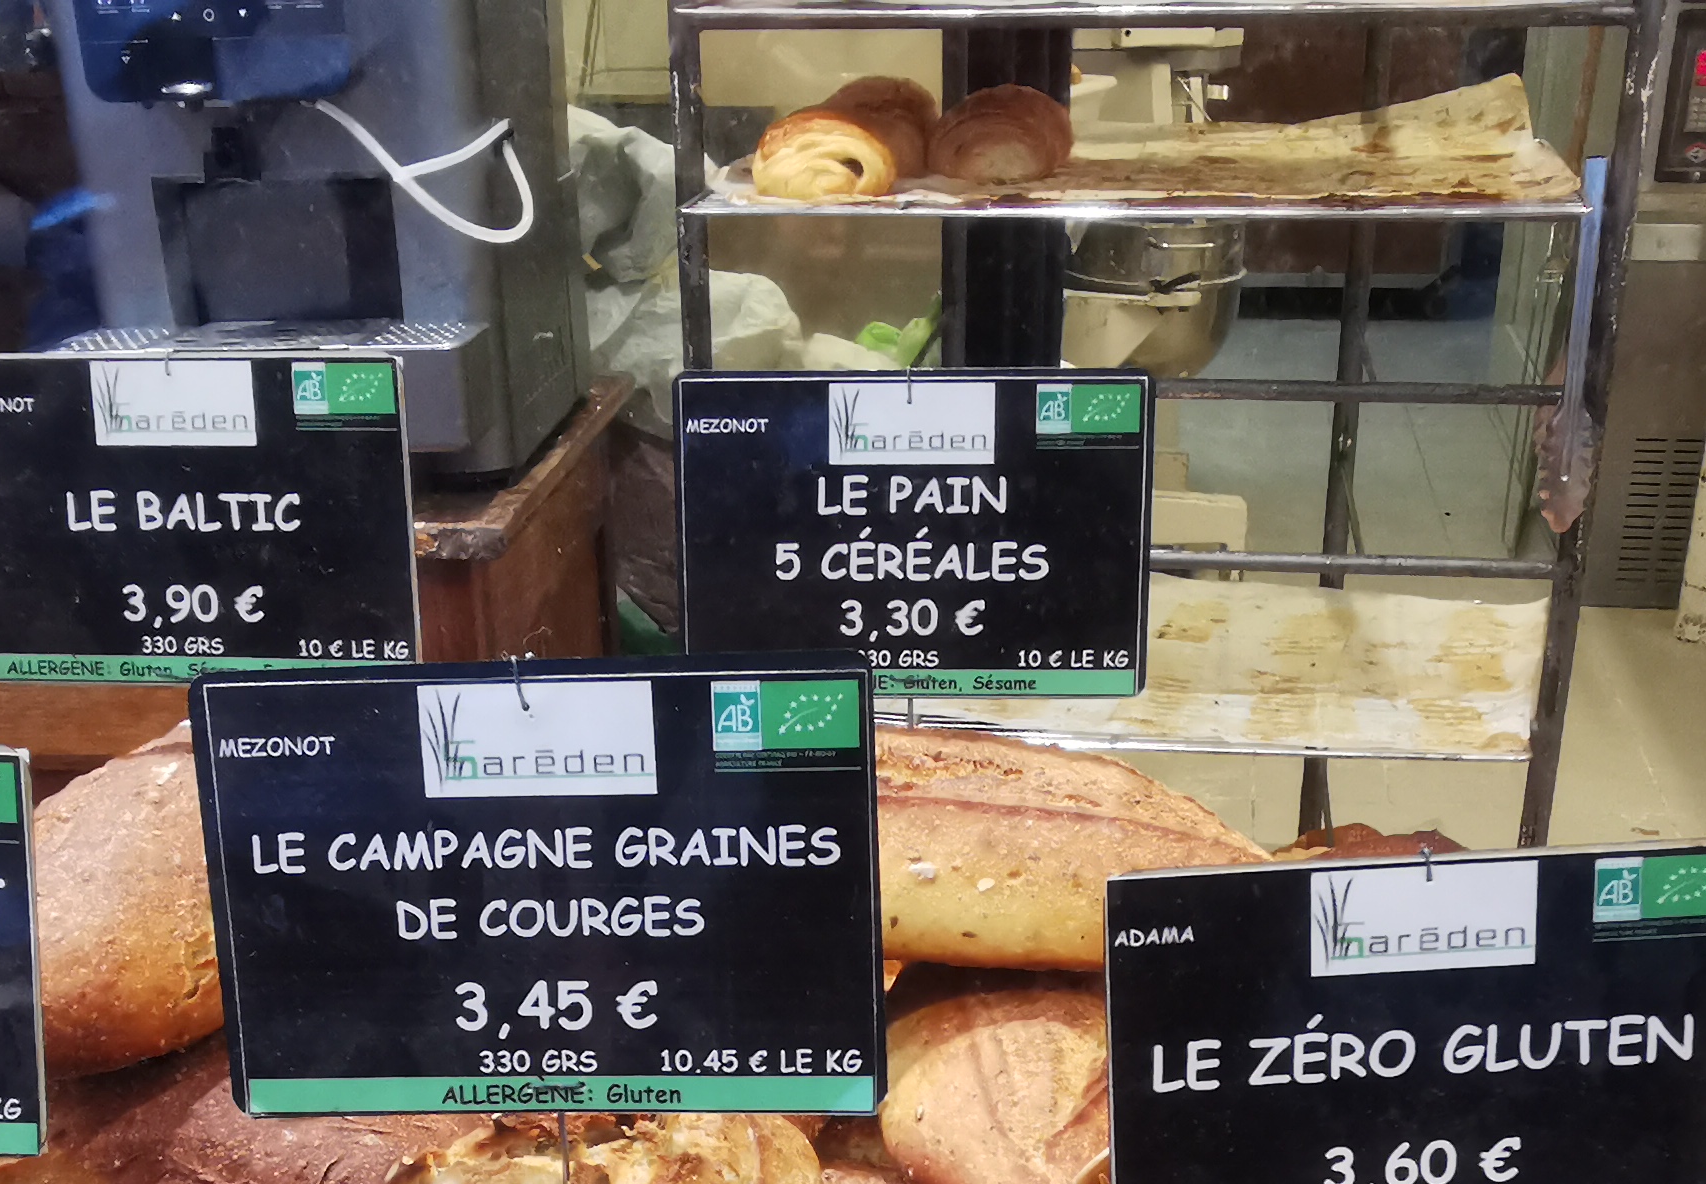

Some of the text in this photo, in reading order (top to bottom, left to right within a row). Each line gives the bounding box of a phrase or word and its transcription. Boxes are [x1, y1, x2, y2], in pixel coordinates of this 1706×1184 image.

[686, 418, 769, 434] MEZONOT
[817, 474, 1007, 516] LE PAIN
[65, 489, 302, 533] LE BALTIC
[775, 527, 1050, 583] 5 CÉRÉALES
[121, 583, 266, 629] 3,90 €
[839, 599, 985, 643] 3,30 €
[141, 636, 224, 655] 330 GRS
[298, 638, 409, 659] 10 € LE KG
[859, 650, 940, 667] 30 GRS
[1017, 650, 1130, 668] 10 € LE KG
[973, 675, 1037, 690] Sésame
[718, 704, 753, 732] AB
[218, 735, 337, 760] MEZONOT
[251, 825, 842, 876] LE CAMPAGNE GRAINES
[1599, 879, 1634, 905] AB
[396, 898, 707, 941] DE COURGES
[1115, 926, 1194, 948] ADAMA
[454, 981, 659, 1041] 3,45 €
[479, 1050, 599, 1074] 330 GRS
[660, 1049, 863, 1075] 10.45 € LE KG
[1153, 1014, 1695, 1094] LE ZÉRO GLUTEN
[607, 1082, 682, 1104] Gluten
[1478, 1137, 1522, 1183] €
